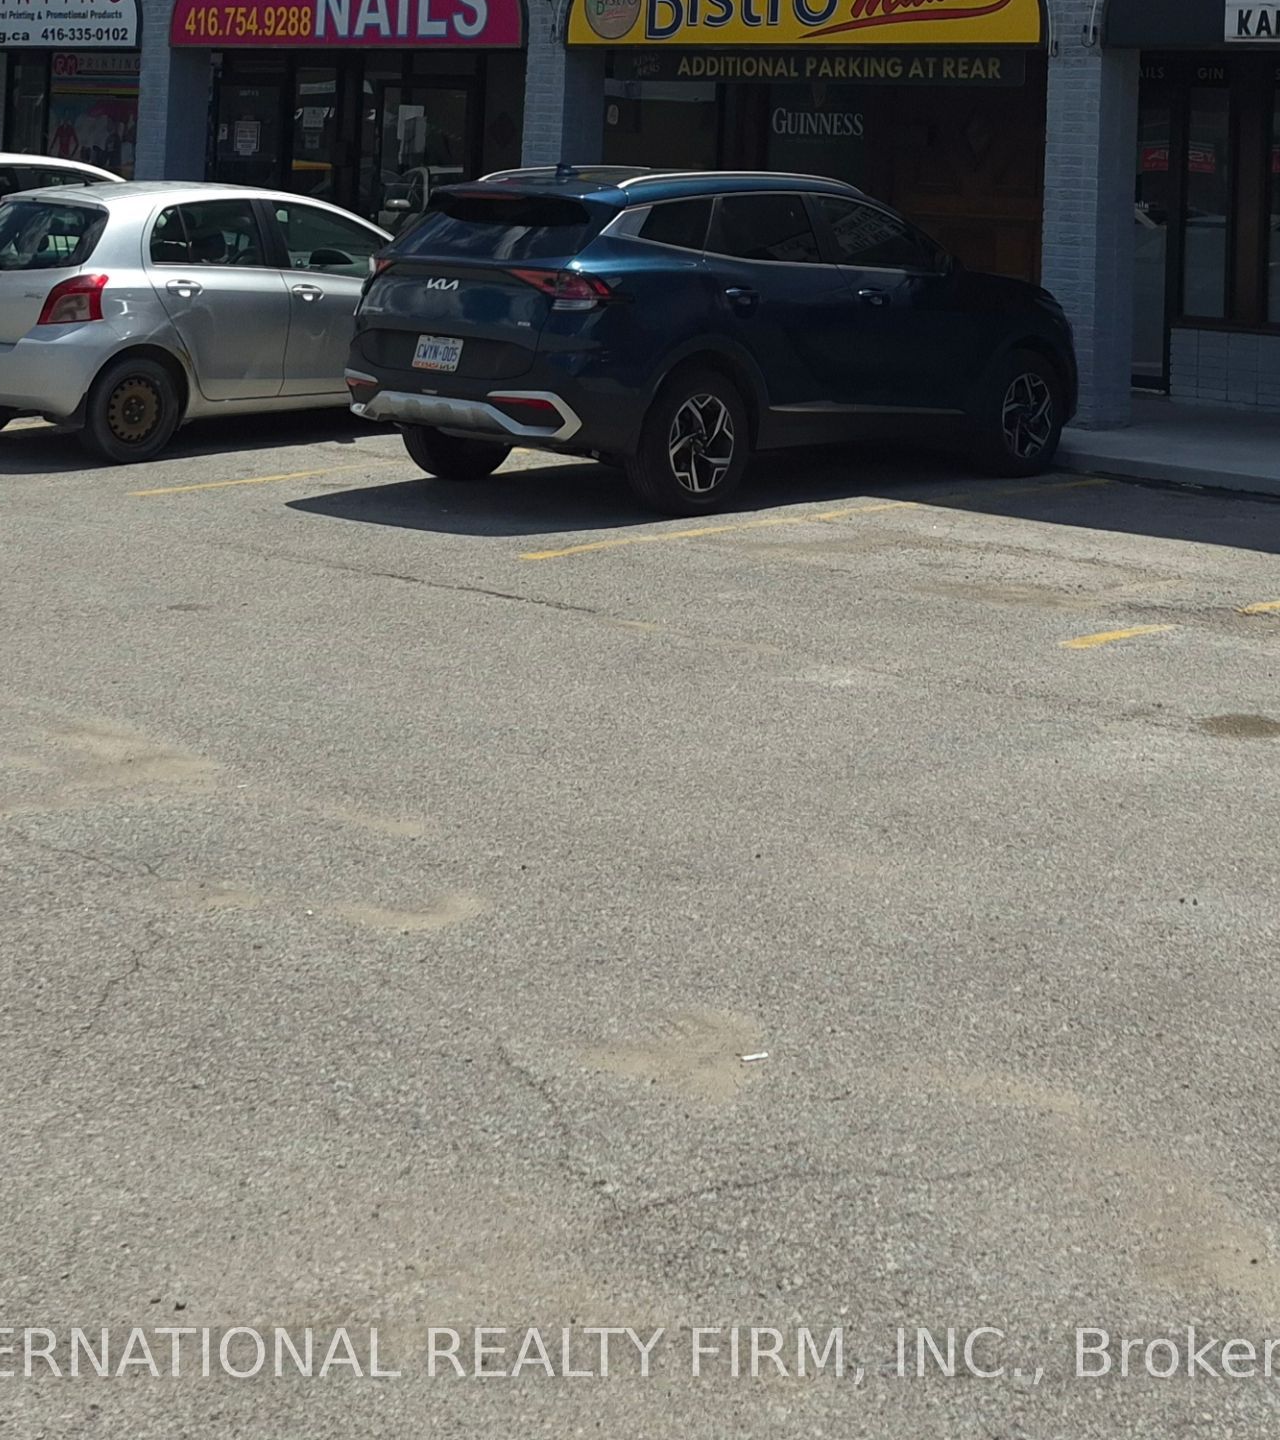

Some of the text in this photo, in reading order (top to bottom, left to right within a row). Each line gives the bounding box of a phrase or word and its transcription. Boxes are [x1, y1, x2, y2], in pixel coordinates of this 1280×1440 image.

[9, 10, 35, 22] Printing
[37, 11, 42, 20] &
[46, 10, 89, 20] Promotional
[90, 9, 123, 20] Products
[185, 6, 312, 37] 416.754.9288
[40, 27, 129, 42] 416-335-0102
[677, 56, 799, 78] ADDITIONAL
[805, 57, 904, 79] PARKING
[908, 57, 938, 79] AT
[942, 58, 1002, 80] REAR
[1197, 67, 1225, 80] GIN
[771, 105, 864, 137] GUINNESS
[426, 278, 460, 291] KIA
